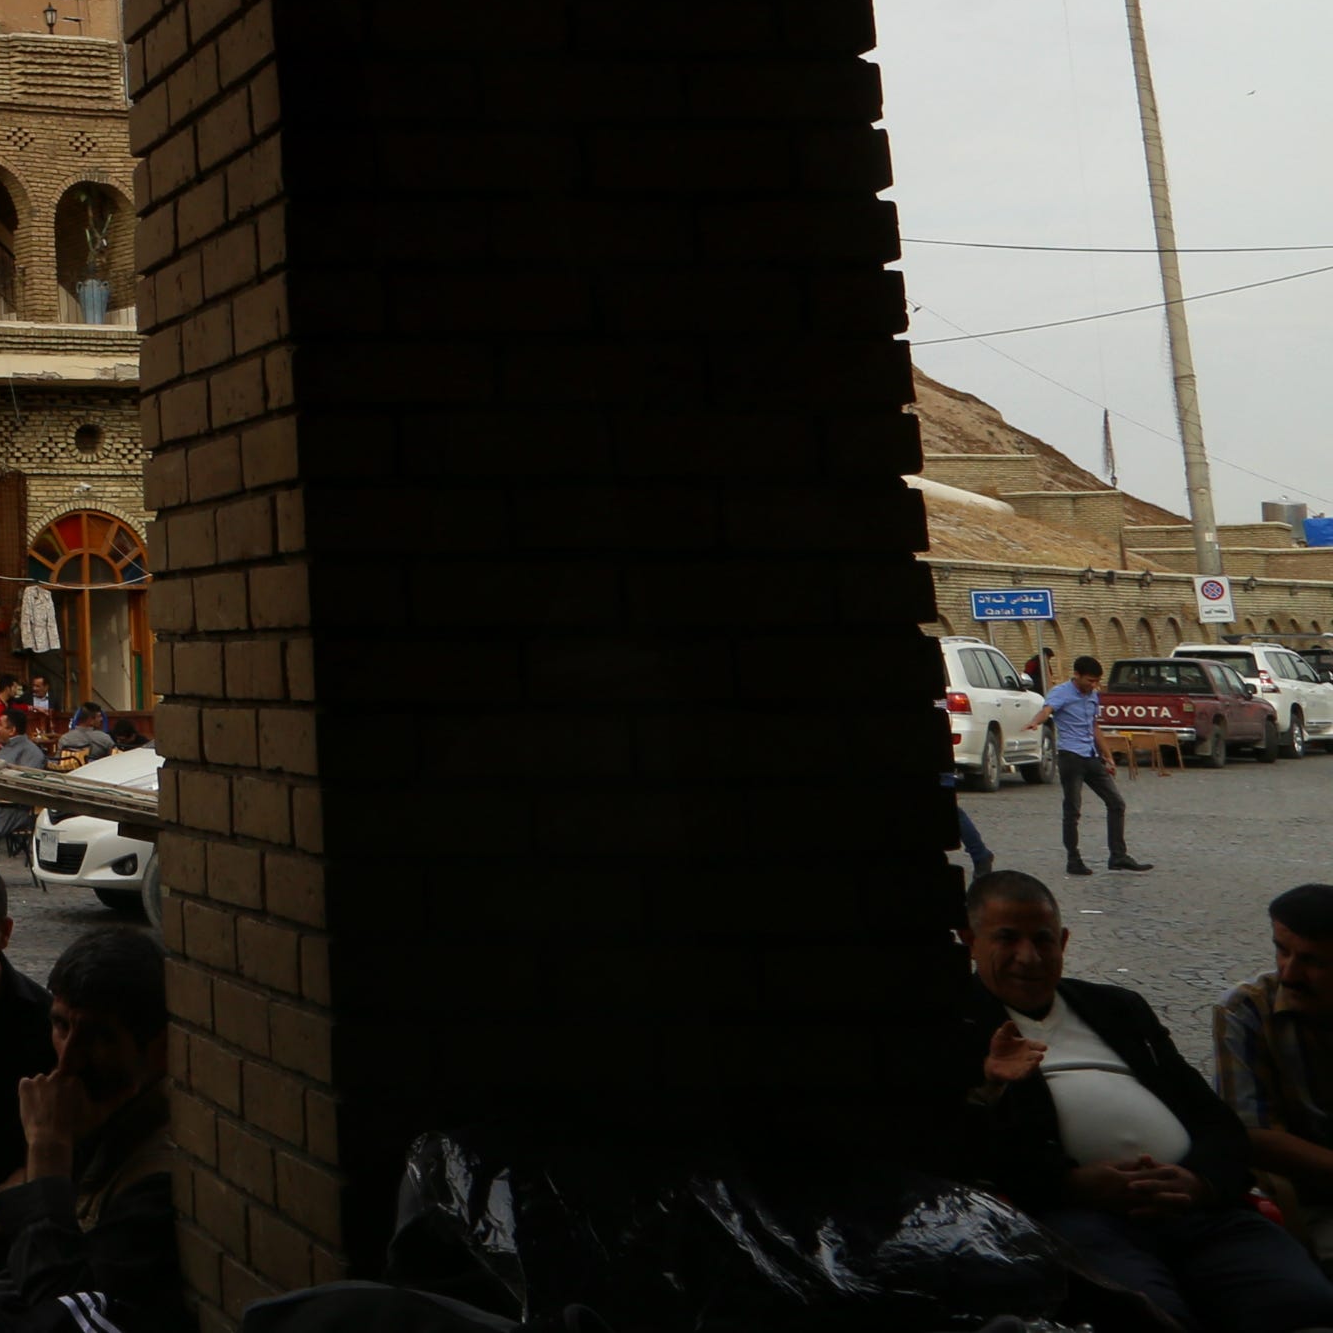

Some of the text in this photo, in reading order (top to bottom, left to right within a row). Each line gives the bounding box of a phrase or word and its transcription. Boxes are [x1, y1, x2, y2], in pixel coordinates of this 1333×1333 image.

[985, 607, 1041, 616] Qalat Str.
[1098, 705, 1173, 719] TOYOTA
